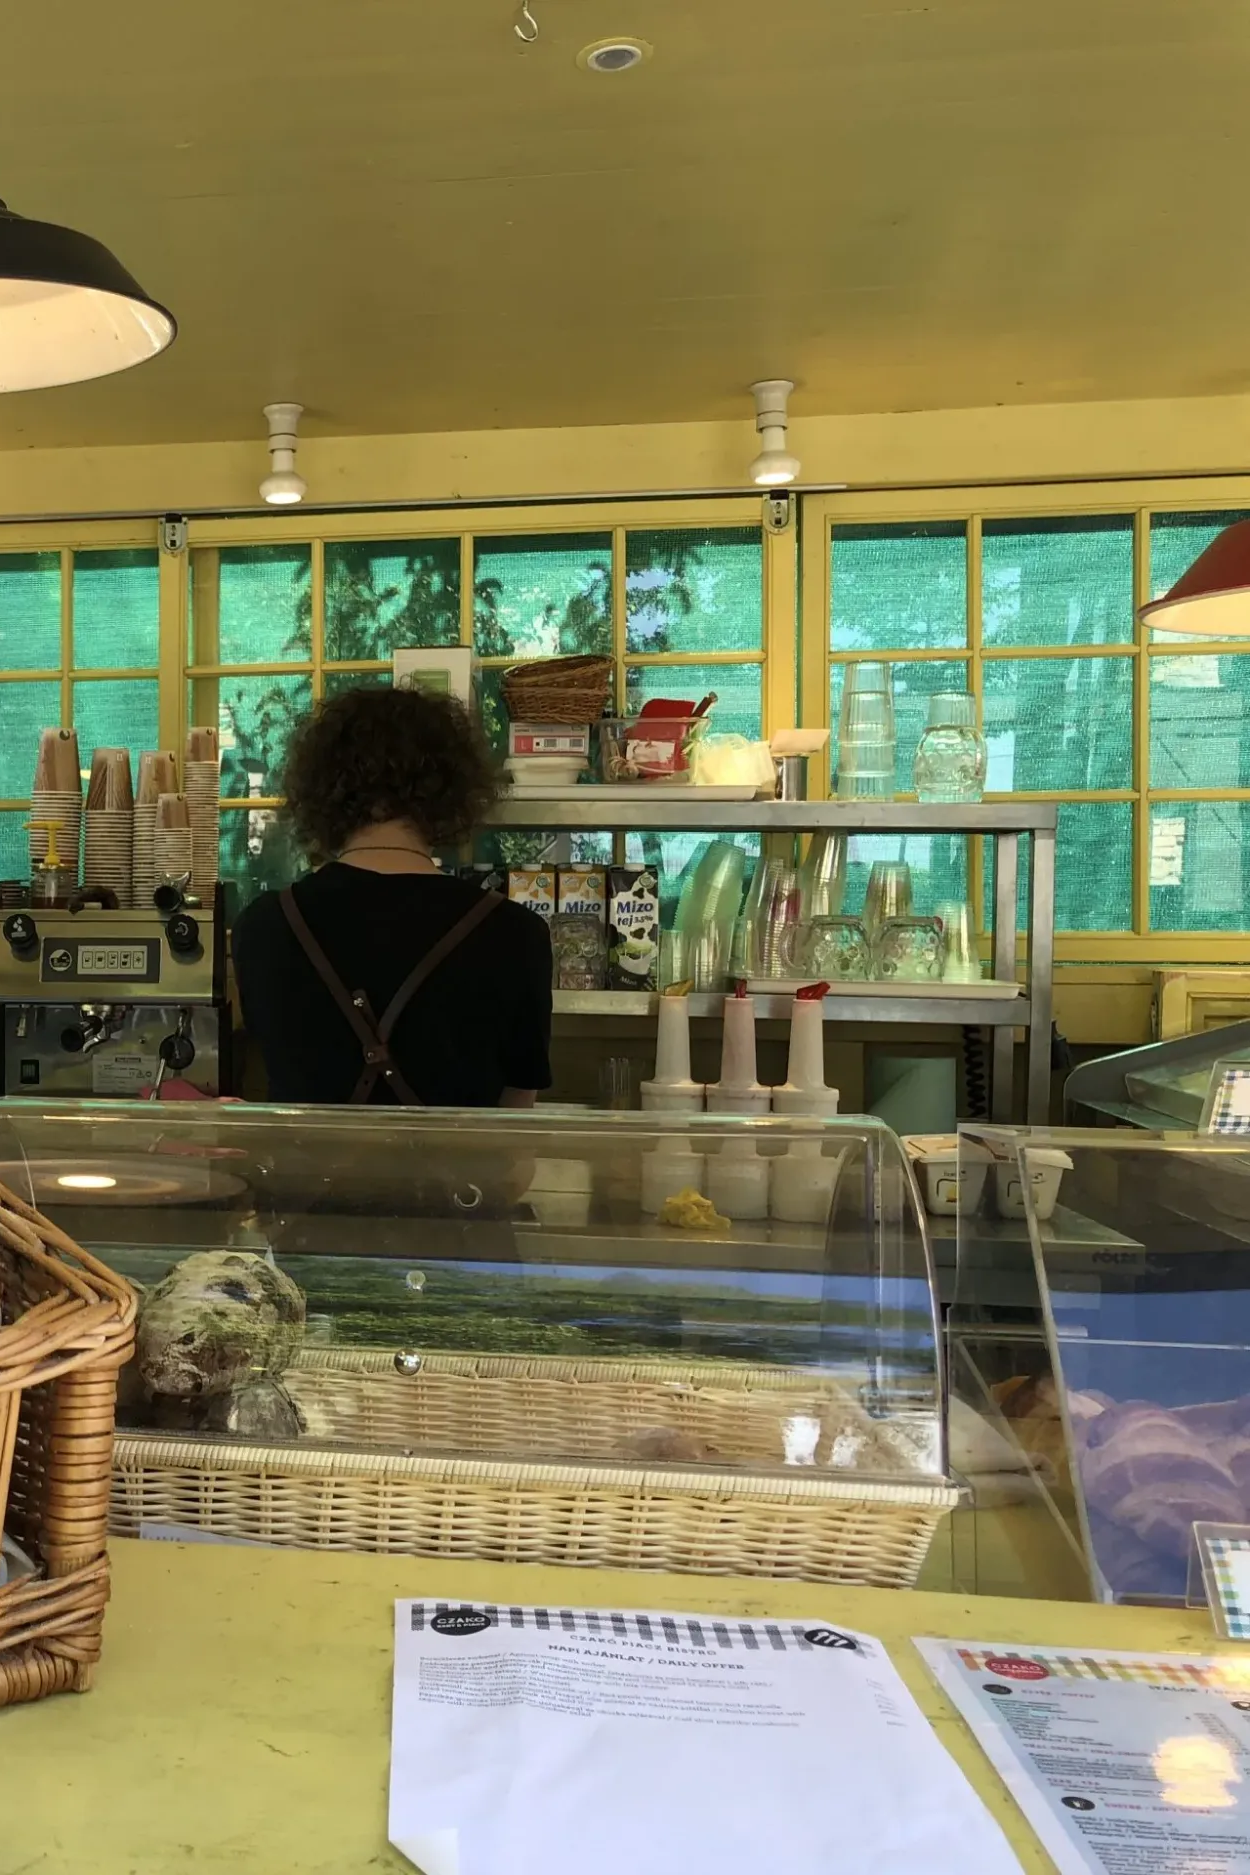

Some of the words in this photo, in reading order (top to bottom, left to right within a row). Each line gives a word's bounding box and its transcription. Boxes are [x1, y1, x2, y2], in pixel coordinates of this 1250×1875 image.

[565, 901, 602, 914] Mizo
[616, 900, 654, 914] Mizo
[617, 916, 633, 927] tej
[436, 1616, 486, 1625] CZAKO
[548, 1644, 580, 1657] NAPI
[658, 1658, 699, 1668] DAILY
[702, 1662, 745, 1670] OFFER
[667, 1646, 717, 1656] BISTRO
